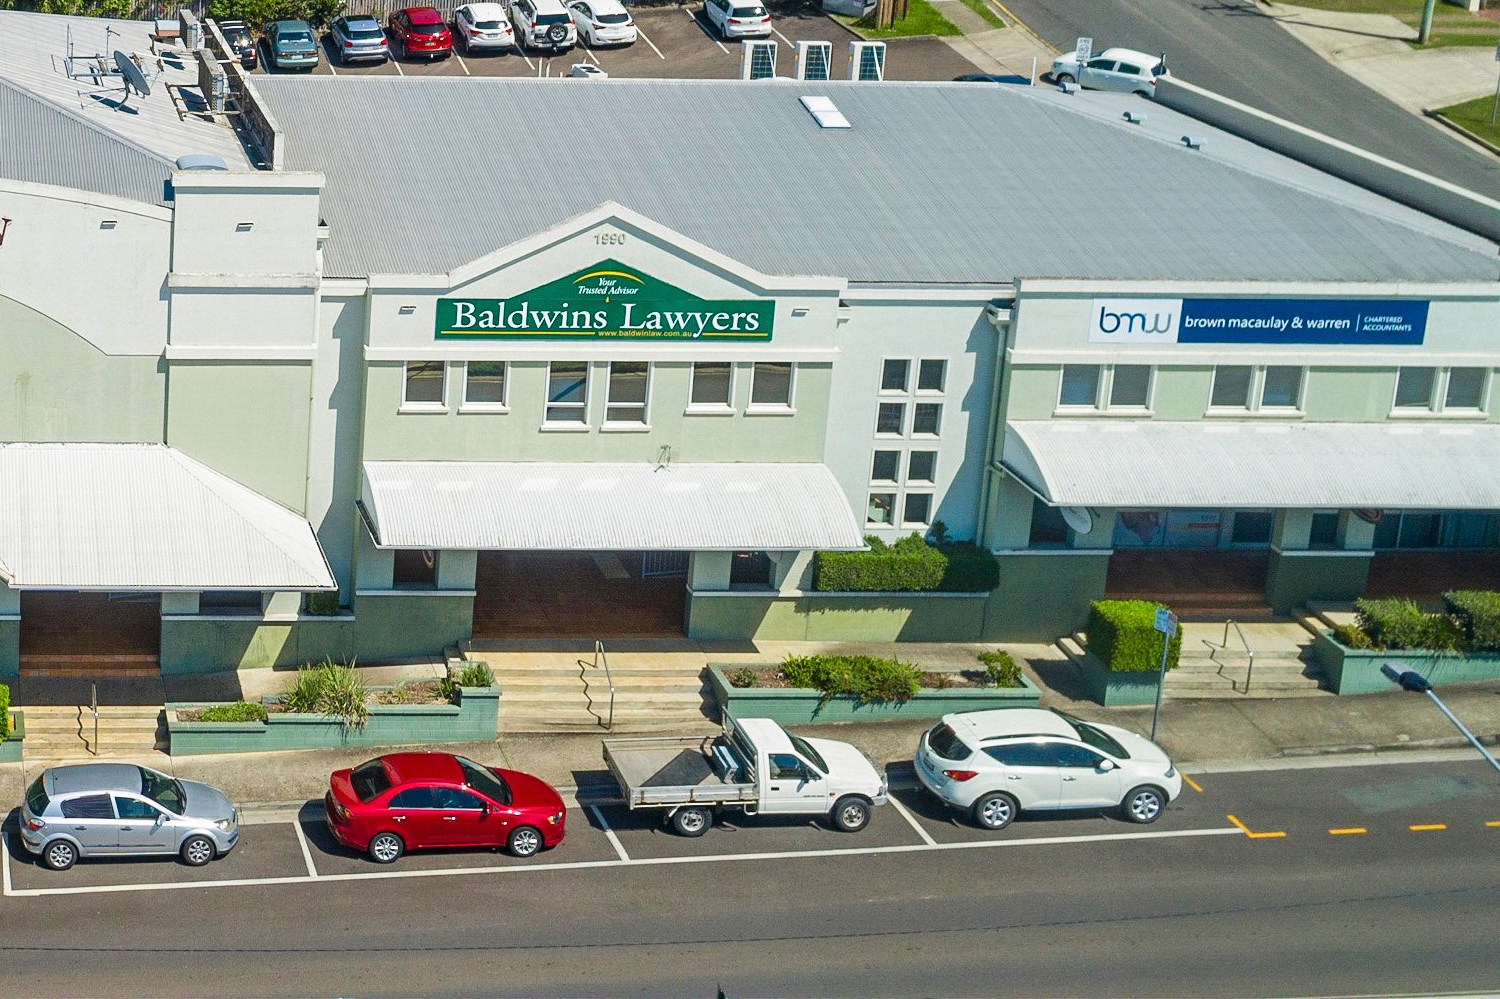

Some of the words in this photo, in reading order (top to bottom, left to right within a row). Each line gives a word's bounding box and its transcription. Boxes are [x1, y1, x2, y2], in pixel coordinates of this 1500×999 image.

[598, 278, 616, 286] Your
[578, 286, 608, 295] Trusted
[608, 286, 639, 295] Advisor
[451, 301, 608, 330] Baldwins
[619, 303, 760, 338] Lawyers
[1099, 306, 1172, 334] bmw
[1185, 315, 1225, 328] brown
[1228, 315, 1289, 332] macaulay
[1291, 316, 1303, 329] &
[1306, 318, 1351, 329] warren
[1362, 324, 1412, 332] ACCOUNTANTS
